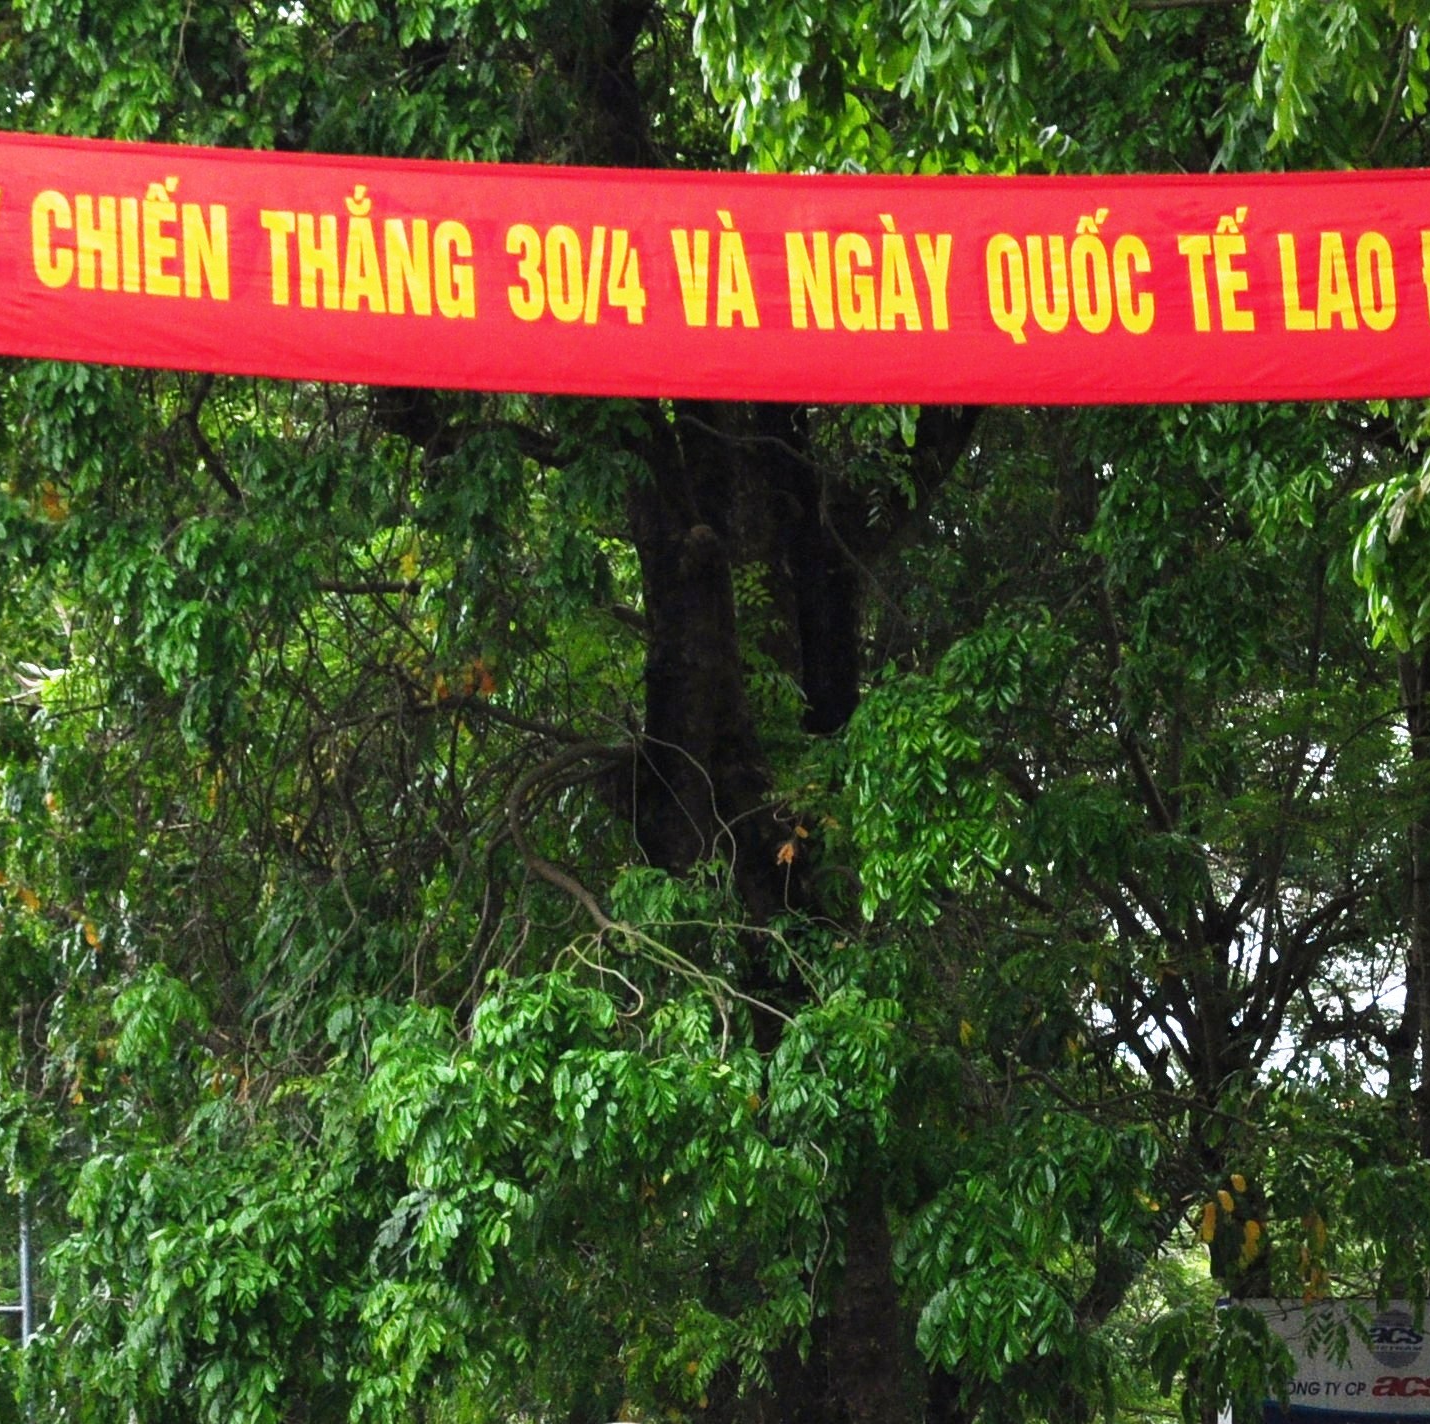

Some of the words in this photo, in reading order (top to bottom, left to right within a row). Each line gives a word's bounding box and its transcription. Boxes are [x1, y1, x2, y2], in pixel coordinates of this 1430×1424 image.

[30, 175, 230, 301] CHIẾN
[259, 184, 476, 319] THẮNG
[505, 223, 647, 325] 30/4
[670, 209, 760, 328] VÀ
[784, 213, 953, 332] NGÀY
[986, 207, 1155, 344] QUỐC
[1177, 206, 1255, 332] TẾ
[1277, 231, 1397, 331] LAO
[1325, 1382, 1342, 1396] TY
